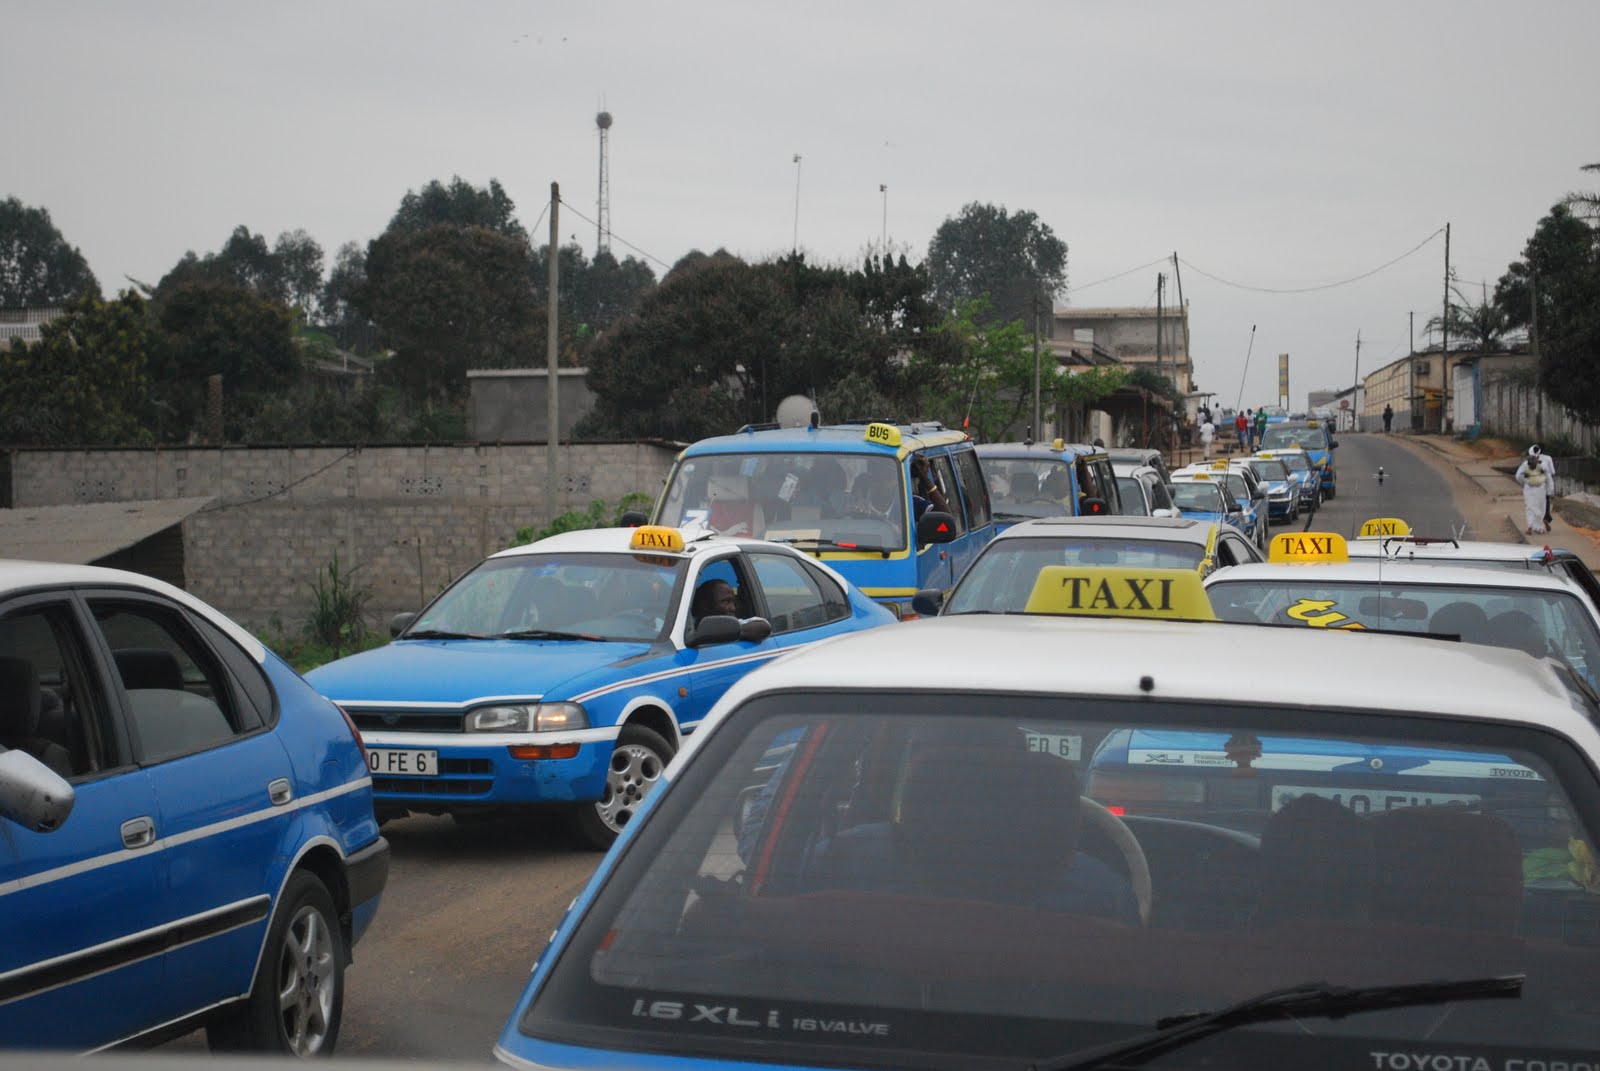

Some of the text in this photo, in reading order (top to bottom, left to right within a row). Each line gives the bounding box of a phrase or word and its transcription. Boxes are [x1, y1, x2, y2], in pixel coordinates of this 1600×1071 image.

[869, 426, 889, 441] BUS
[1365, 523, 1397, 536] TAXI
[637, 532, 673, 548] TAXI
[1281, 537, 1334, 555] TAXI
[1062, 577, 1175, 611] TAXI
[1059, 738, 1069, 756] 6
[388, 752, 409, 772] FE
[416, 753, 427, 772] 6
[1492, 768, 1533, 779] TOYOTA
[1370, 1052, 1492, 1071] TOYOTA
